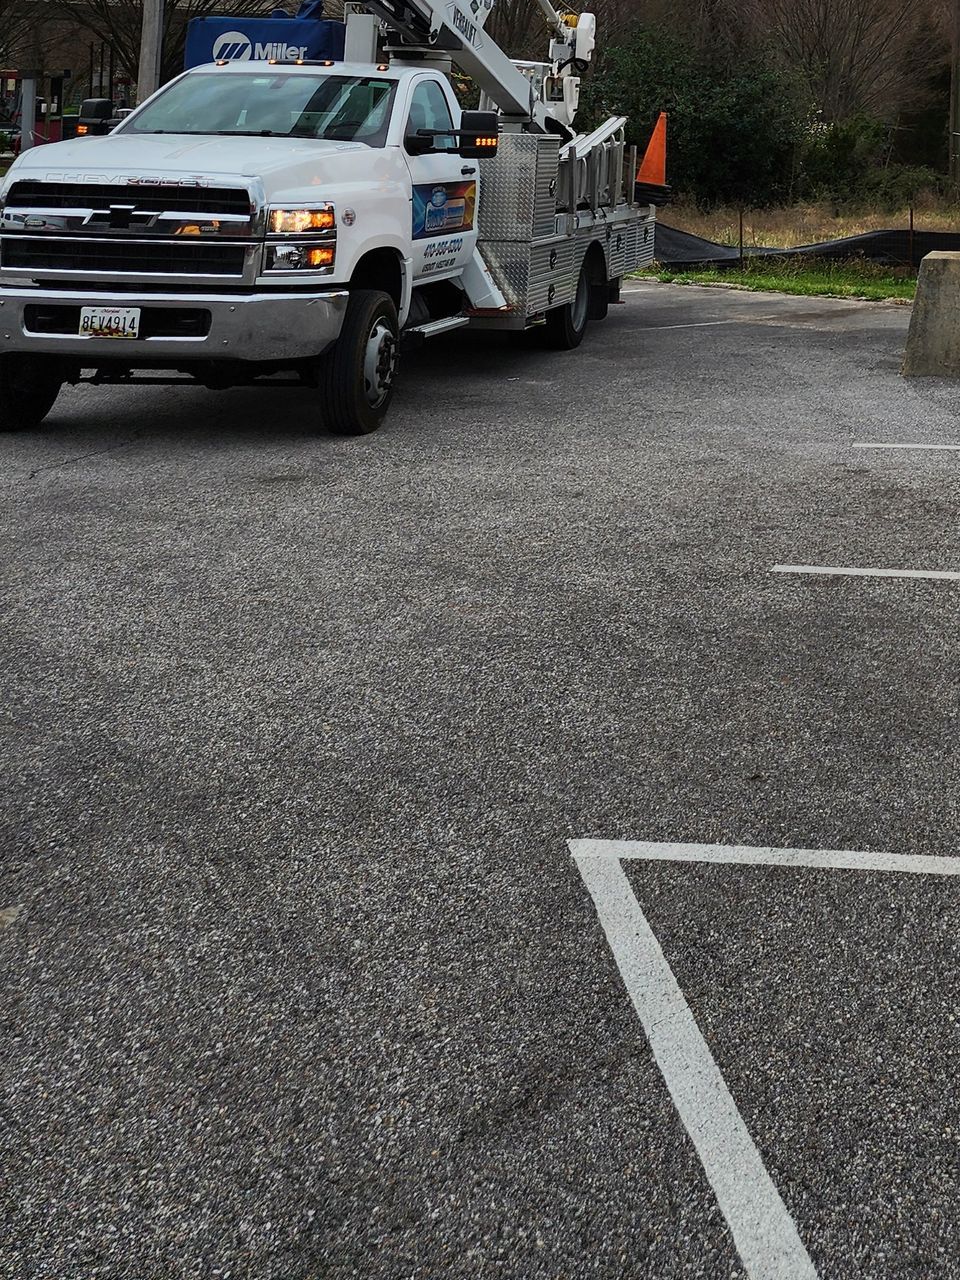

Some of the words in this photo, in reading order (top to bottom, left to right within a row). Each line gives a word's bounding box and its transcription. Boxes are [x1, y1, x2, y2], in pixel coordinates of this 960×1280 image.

[452, 5, 477, 46] VERSALIFT
[254, 41, 307, 61] Miller
[45, 173, 215, 188] CHEVROLET
[82, 315, 137, 332] 8EV4914
